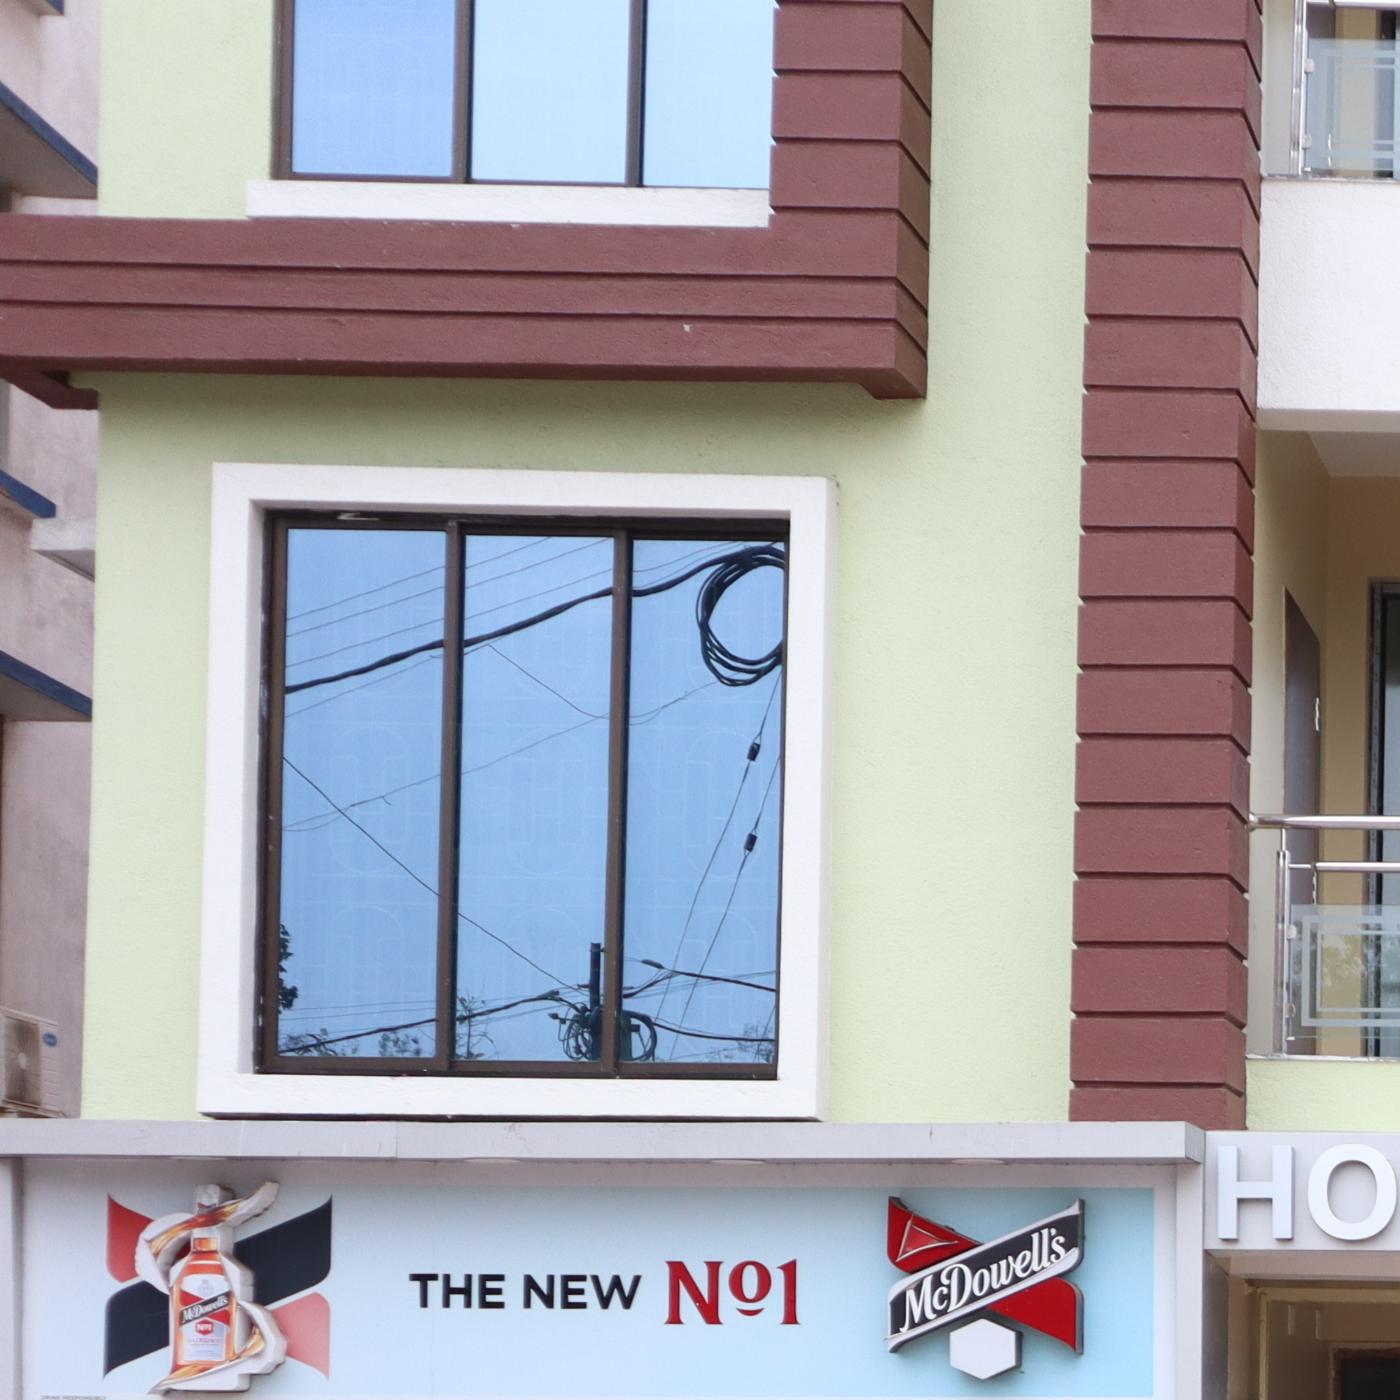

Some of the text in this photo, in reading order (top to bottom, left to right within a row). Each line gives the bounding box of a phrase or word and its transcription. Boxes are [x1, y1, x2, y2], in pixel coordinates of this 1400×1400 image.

[409, 1273, 505, 1309] THE
[523, 1274, 642, 1310] NEW
[899, 1227, 1067, 1334] McDowell's
